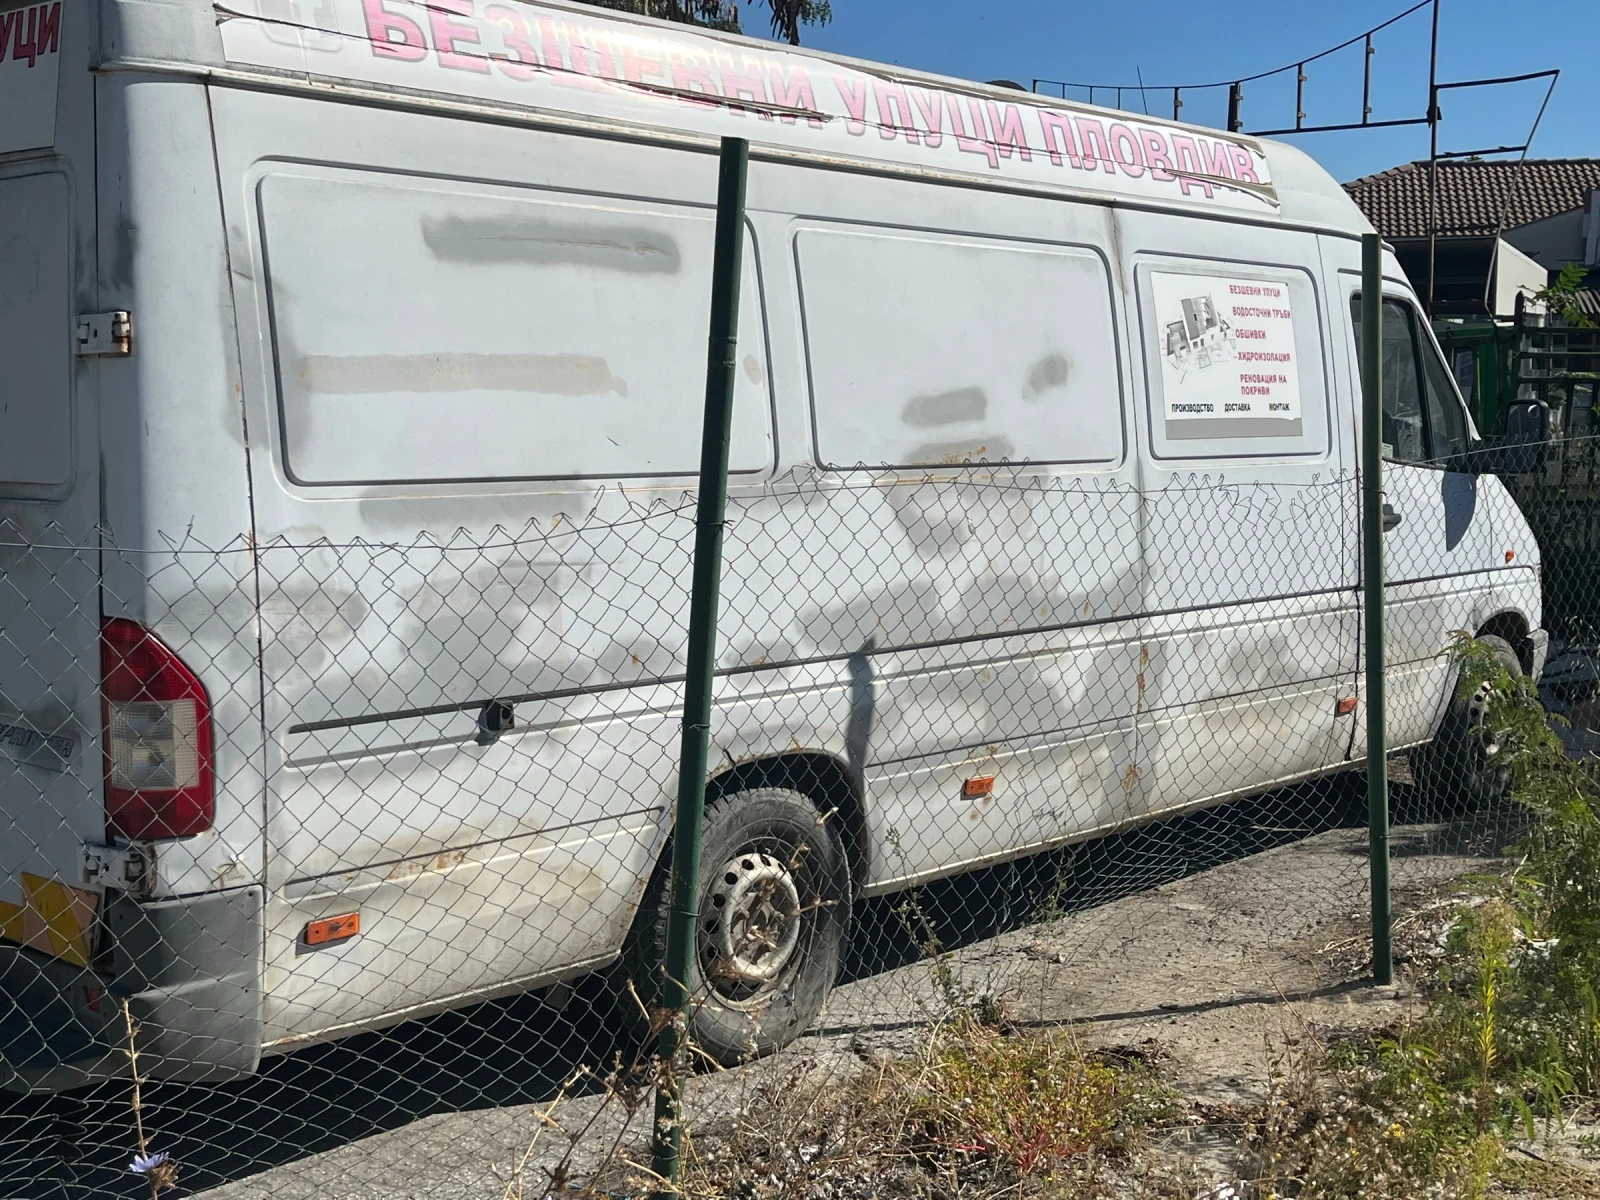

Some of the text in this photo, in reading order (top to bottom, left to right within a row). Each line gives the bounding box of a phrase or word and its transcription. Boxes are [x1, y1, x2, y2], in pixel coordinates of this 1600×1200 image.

[832, 72, 1032, 169] УЛУЦИ
[1037, 109, 1260, 199] ПЛОВДИВ
[1229, 284, 1261, 296] БЕЗШЕВНИ
[1232, 306, 1291, 319] ВОДОСТОЧНИ ТРЪБИ
[1235, 328, 1266, 339] ОБШИВКИ
[1240, 374, 1287, 384] РЕНОВАЦИЯ НА
[1241, 386, 1270, 395] ПОКРИВИ
[1171, 402, 1290, 413] ПРОИЗВОДСТВО ДОСТАВКА МОНТАЖ
